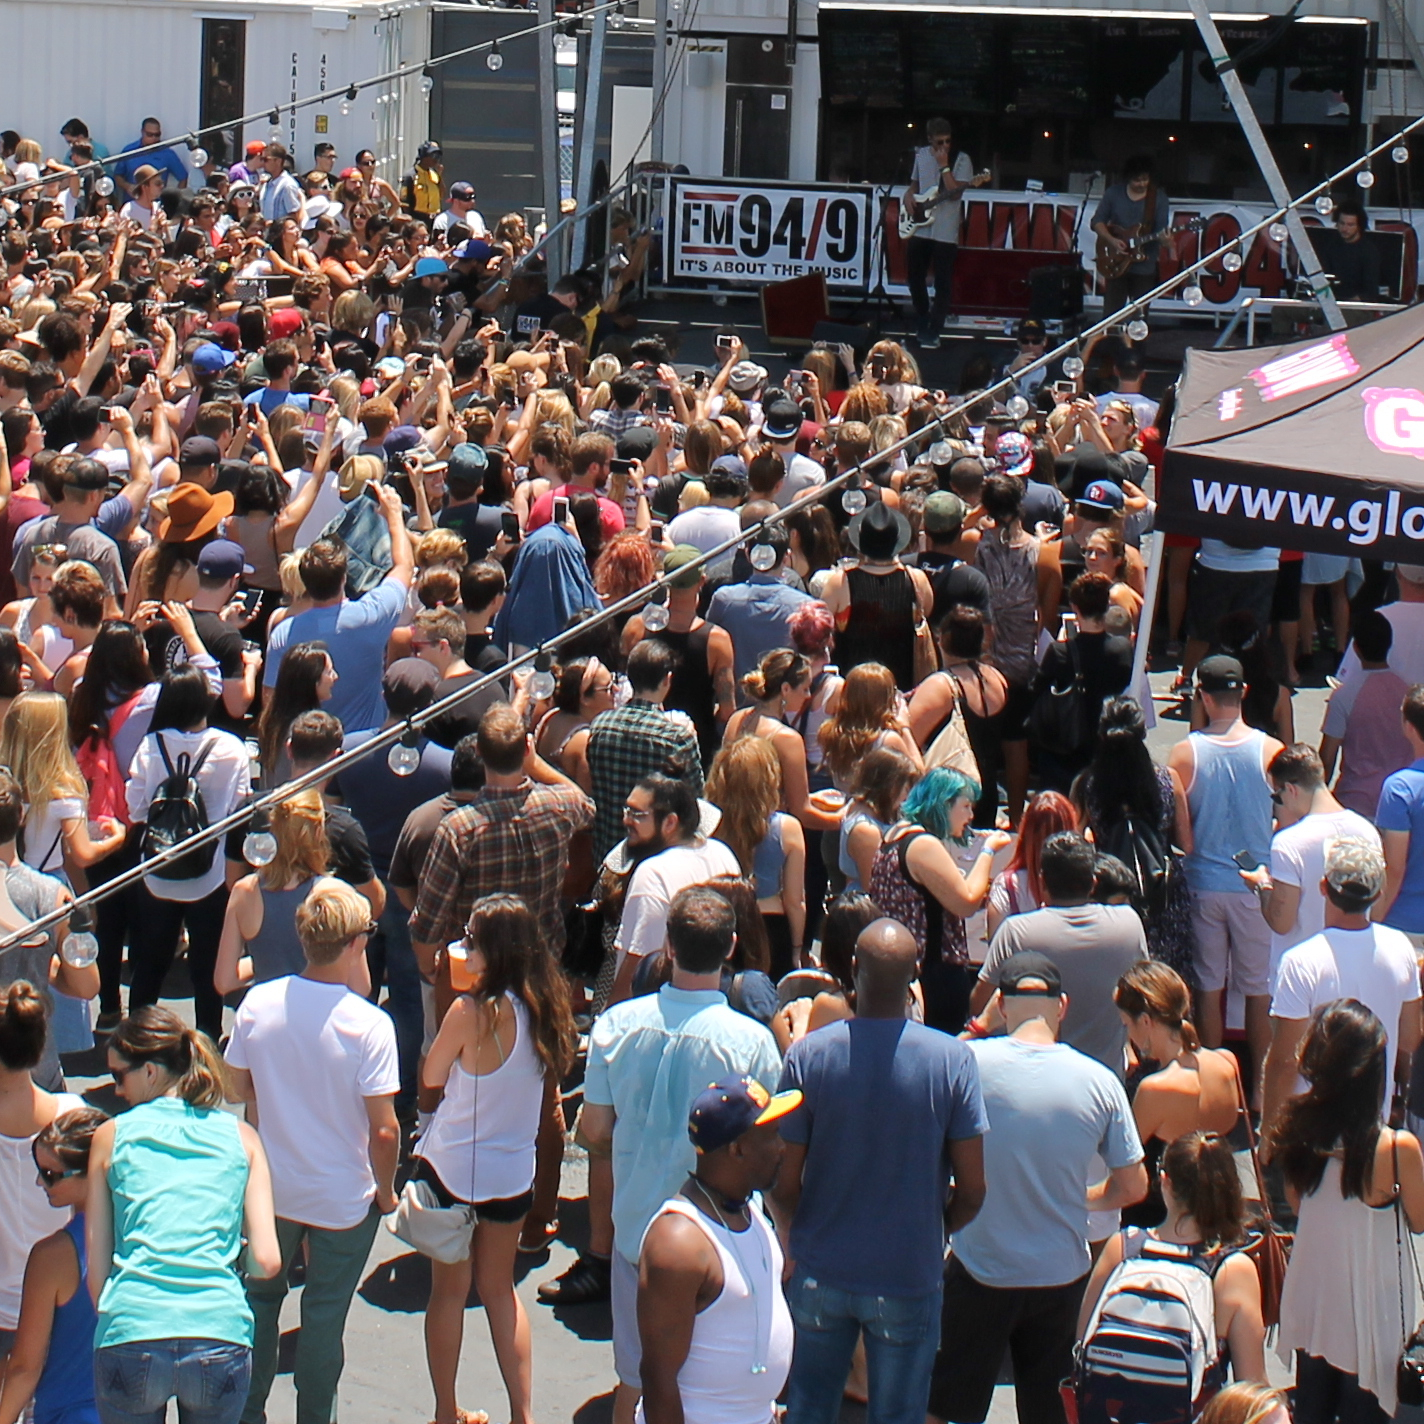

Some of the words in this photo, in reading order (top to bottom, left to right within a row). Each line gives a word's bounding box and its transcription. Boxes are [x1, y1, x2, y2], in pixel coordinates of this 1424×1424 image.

[680, 259, 708, 272] IT'S
[712, 261, 767, 275] ABOUT
[771, 263, 803, 277] THE
[807, 265, 858, 280] MUSIC
